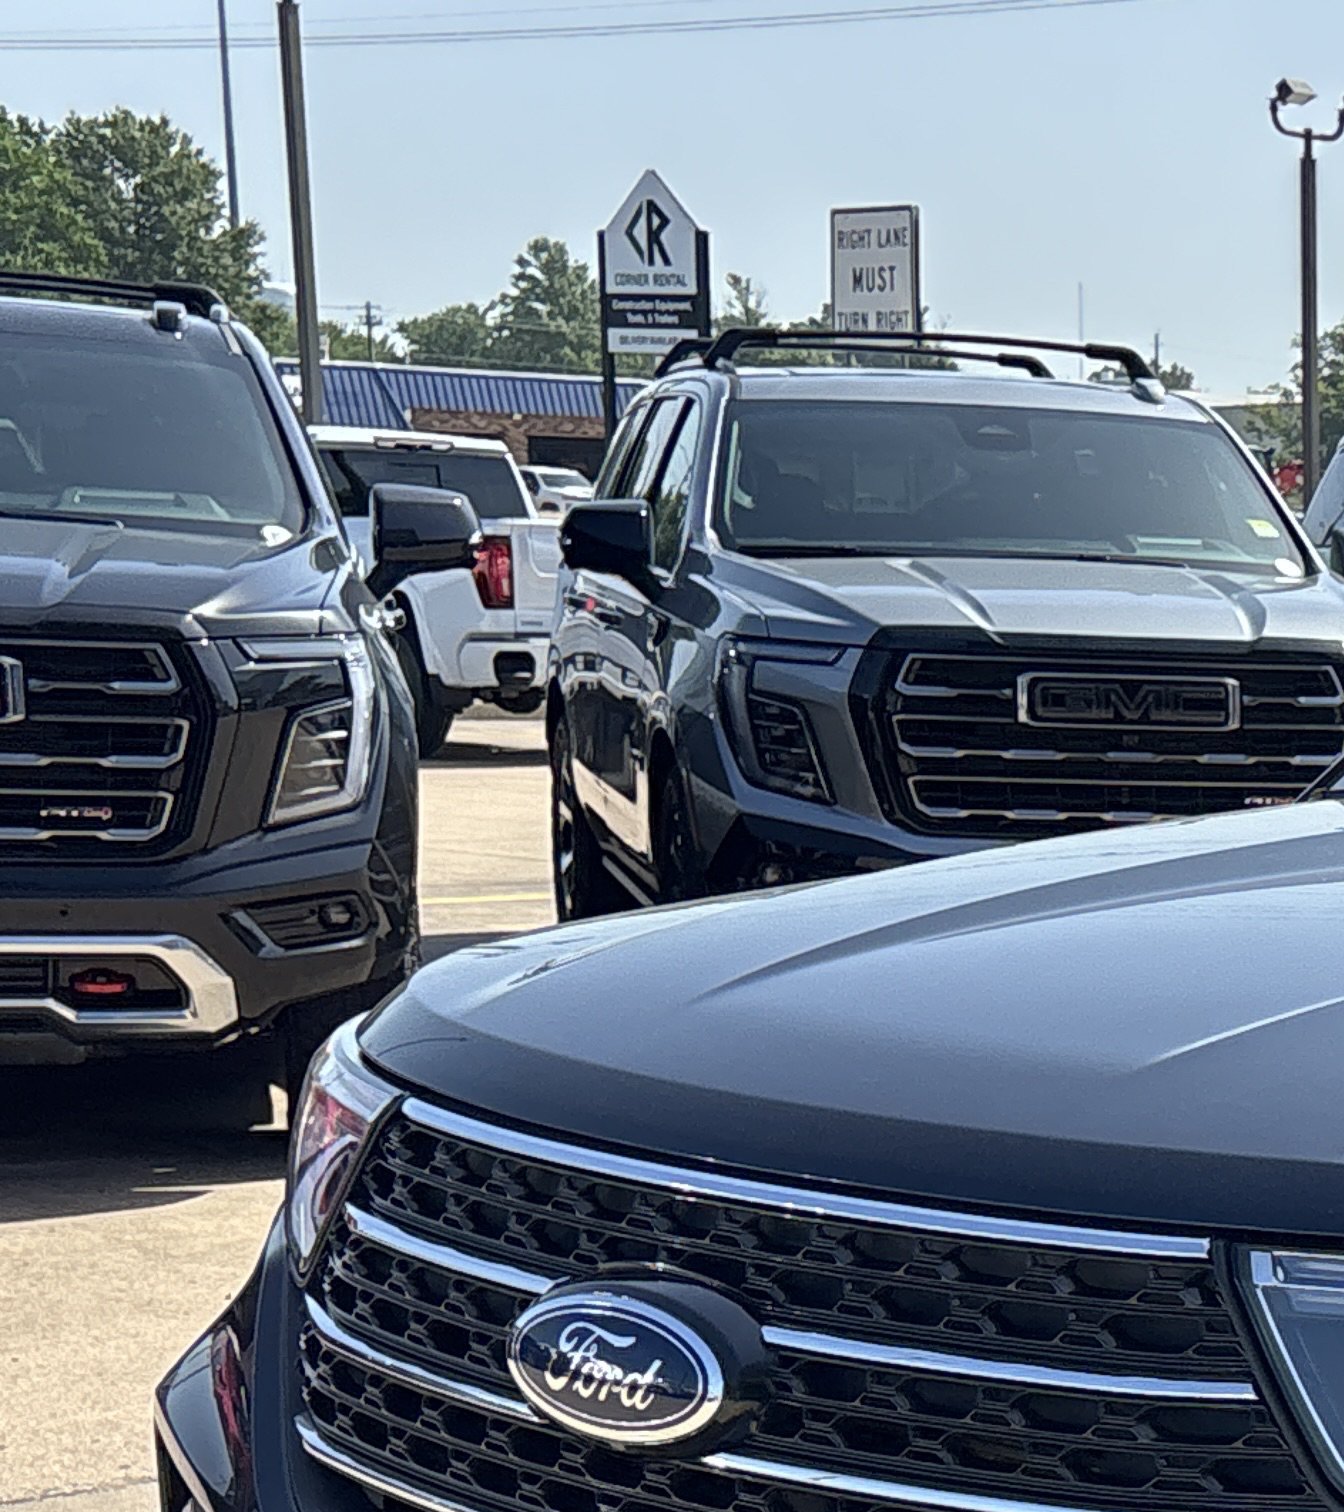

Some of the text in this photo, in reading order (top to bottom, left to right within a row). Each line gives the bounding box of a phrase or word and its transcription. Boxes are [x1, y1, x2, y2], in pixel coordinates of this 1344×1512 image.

[837, 226, 909, 249] RIGHT LANE
[852, 265, 896, 293] MUST
[837, 310, 910, 331] TURN RIGHT
[1034, 681, 1226, 722] GMC
[544, 1321, 664, 1411] Ford
